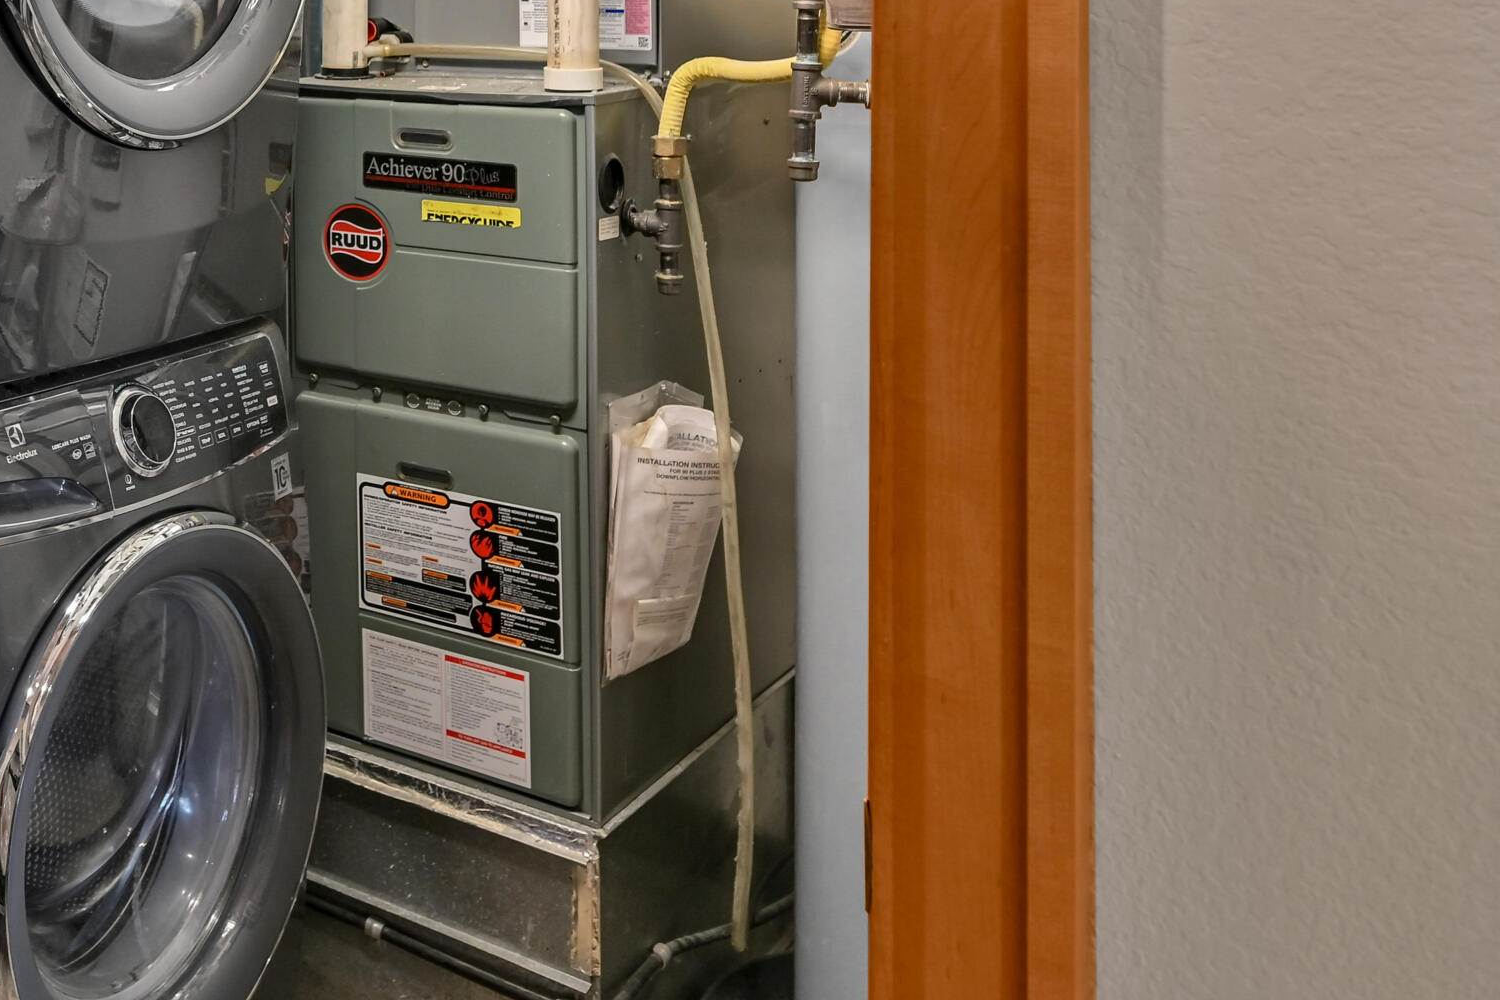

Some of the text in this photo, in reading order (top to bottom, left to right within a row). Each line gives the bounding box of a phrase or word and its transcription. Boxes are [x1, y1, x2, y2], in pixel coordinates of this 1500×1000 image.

[366, 156, 439, 180] Achiever
[332, 232, 381, 250] RUUD
[6, 449, 38, 464] Electrolux
[637, 457, 689, 469] INSTALLATION
[399, 489, 437, 503] WARNING
